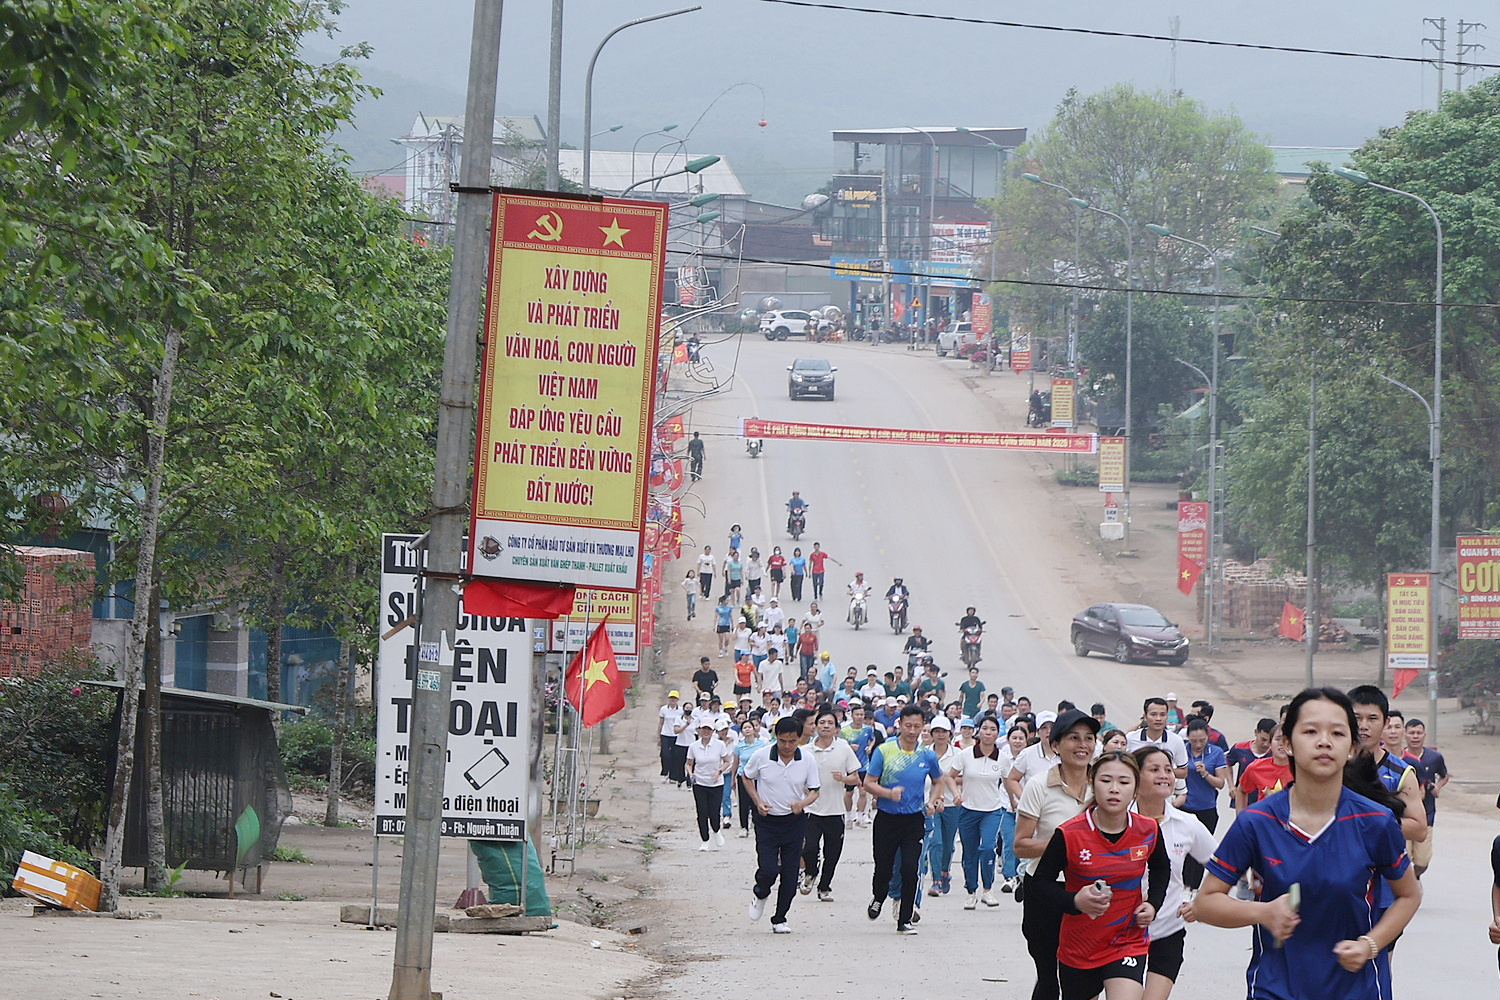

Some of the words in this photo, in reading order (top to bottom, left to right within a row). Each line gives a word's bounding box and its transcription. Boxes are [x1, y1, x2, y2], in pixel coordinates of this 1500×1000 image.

[544, 264, 570, 290] XÂY
[572, 269, 608, 296] DỰNG
[528, 298, 543, 324] VÀ
[547, 301, 580, 327] PHÁT
[583, 300, 620, 330] TRIỂN
[505, 332, 531, 359] VĂN
[534, 335, 563, 364] HOÁ,
[567, 341, 594, 364] CON
[597, 340, 636, 367] NGƯỜI
[538, 371, 565, 401] VIỆT
[568, 376, 598, 400] NAM
[509, 404, 535, 429] ĐÁP
[538, 404, 565, 433] ỨNG
[569, 408, 592, 435] YÊU
[596, 408, 622, 437] CẦU
[493, 439, 526, 465] PHÁT
[530, 437, 566, 468] TRIỂN
[569, 441, 595, 471] BỀN
[599, 446, 633, 474] VỮNG
[527, 474, 551, 502] ĐẤT
[554, 478, 594, 506] NƯỚC!
[1460, 547, 1489, 557] QUANG
[598, 604, 630, 614] MINH!
[601, 590, 629, 602] CÁCH
[391, 698, 518, 745] TOẠI
[454, 795, 482, 815] điện
[486, 795, 519, 817] thoại
[382, 820, 395, 832] ĐT:
[454, 821, 466, 833] Fb:
[467, 819, 495, 837] Nguyễn
[497, 823, 520, 838] Thuận
